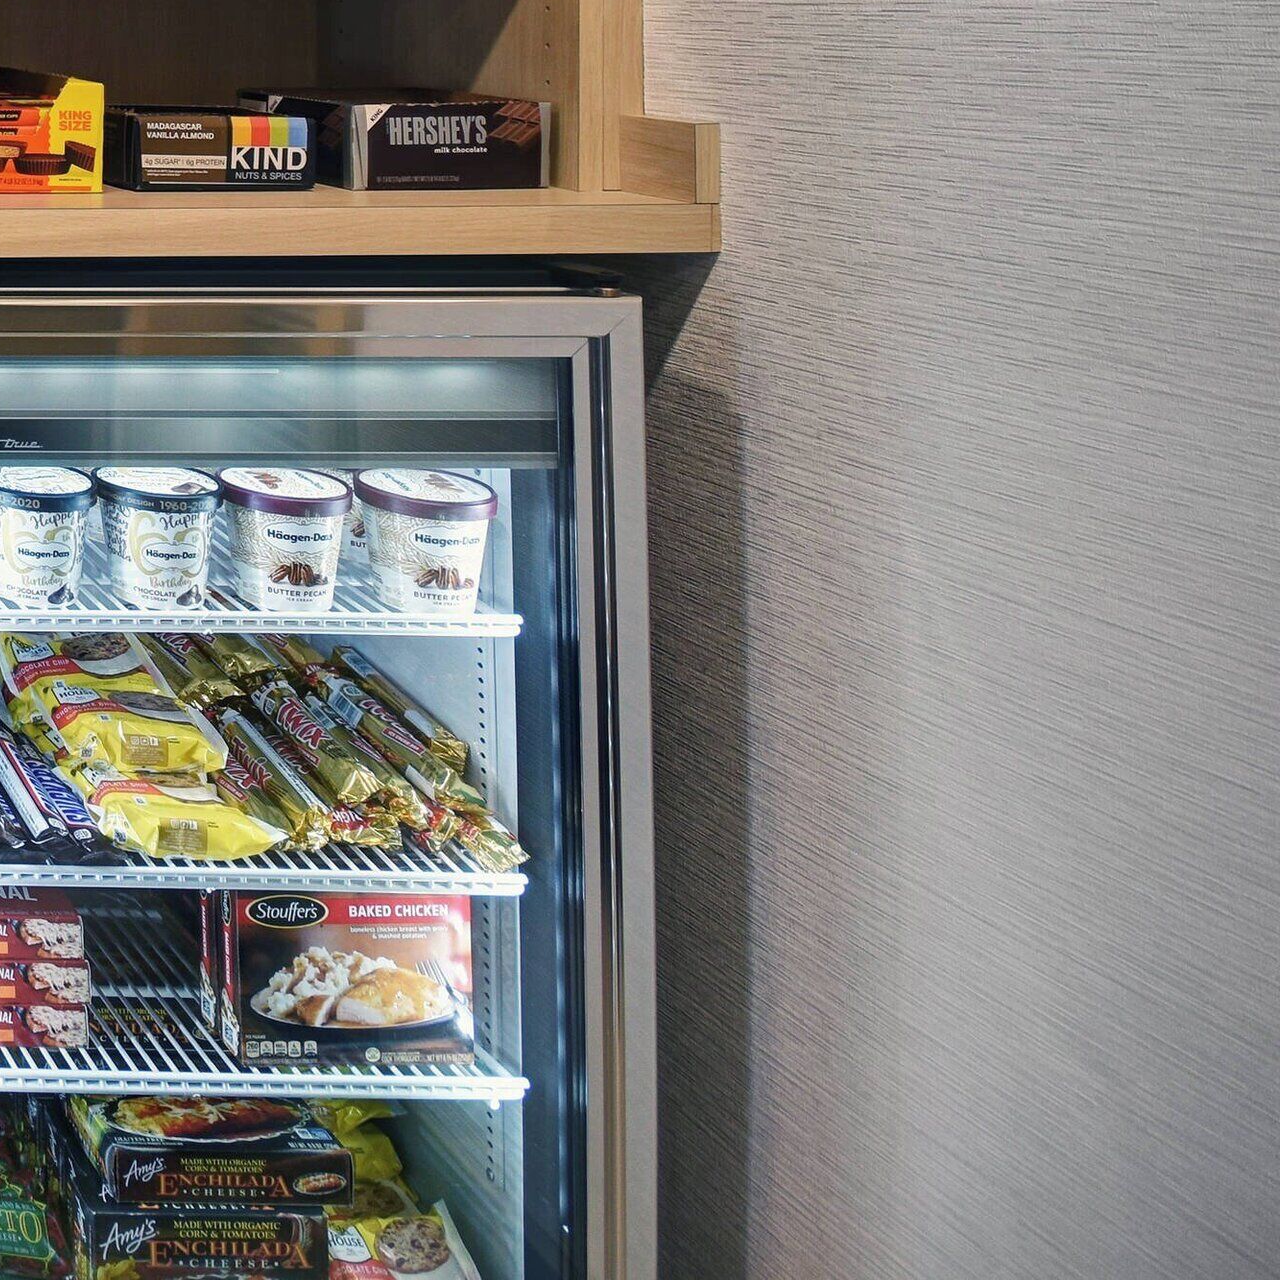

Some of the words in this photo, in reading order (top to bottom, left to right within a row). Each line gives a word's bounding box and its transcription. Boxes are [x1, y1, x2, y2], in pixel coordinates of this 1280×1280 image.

[58, 110, 92, 121] KING
[369, 108, 384, 123] KING
[58, 120, 92, 131] SIZE
[146, 122, 202, 131] MADAGASCAR
[389, 115, 487, 145] HERSHEY'S
[180, 132, 215, 140] ALMOND
[434, 146, 450, 154] milk
[451, 146, 488, 154] chocolate
[144, 158, 153, 166] 4g
[186, 159, 195, 167] 6g
[231, 146, 308, 170] KIND
[235, 171, 259, 180] NUTS
[262, 172, 269, 180] &
[269, 172, 303, 181] SPICES
[267, 586, 302, 597] BUTTER
[276, 697, 332, 749] TWIX
[255, 901, 318, 922] Stouffer's
[348, 904, 392, 918] BAKED
[394, 903, 449, 917] CHICKEN
[180, 1158, 203, 1166] MADE
[203, 1158, 222, 1166] WITH
[222, 1158, 268, 1166] ORGANIC
[122, 1157, 166, 1187] Amy's
[156, 1173, 293, 1198] ENCHILADA
[173, 1220, 204, 1230] MADE
[206, 1221, 231, 1230] WITH
[232, 1221, 281, 1230] ORGANIC
[100, 1219, 158, 1260] Amy's
[179, 1230, 208, 1239] CORN
[219, 1230, 277, 1240] TOMATOES
[148, 1239, 313, 1269] ENCHILADA
